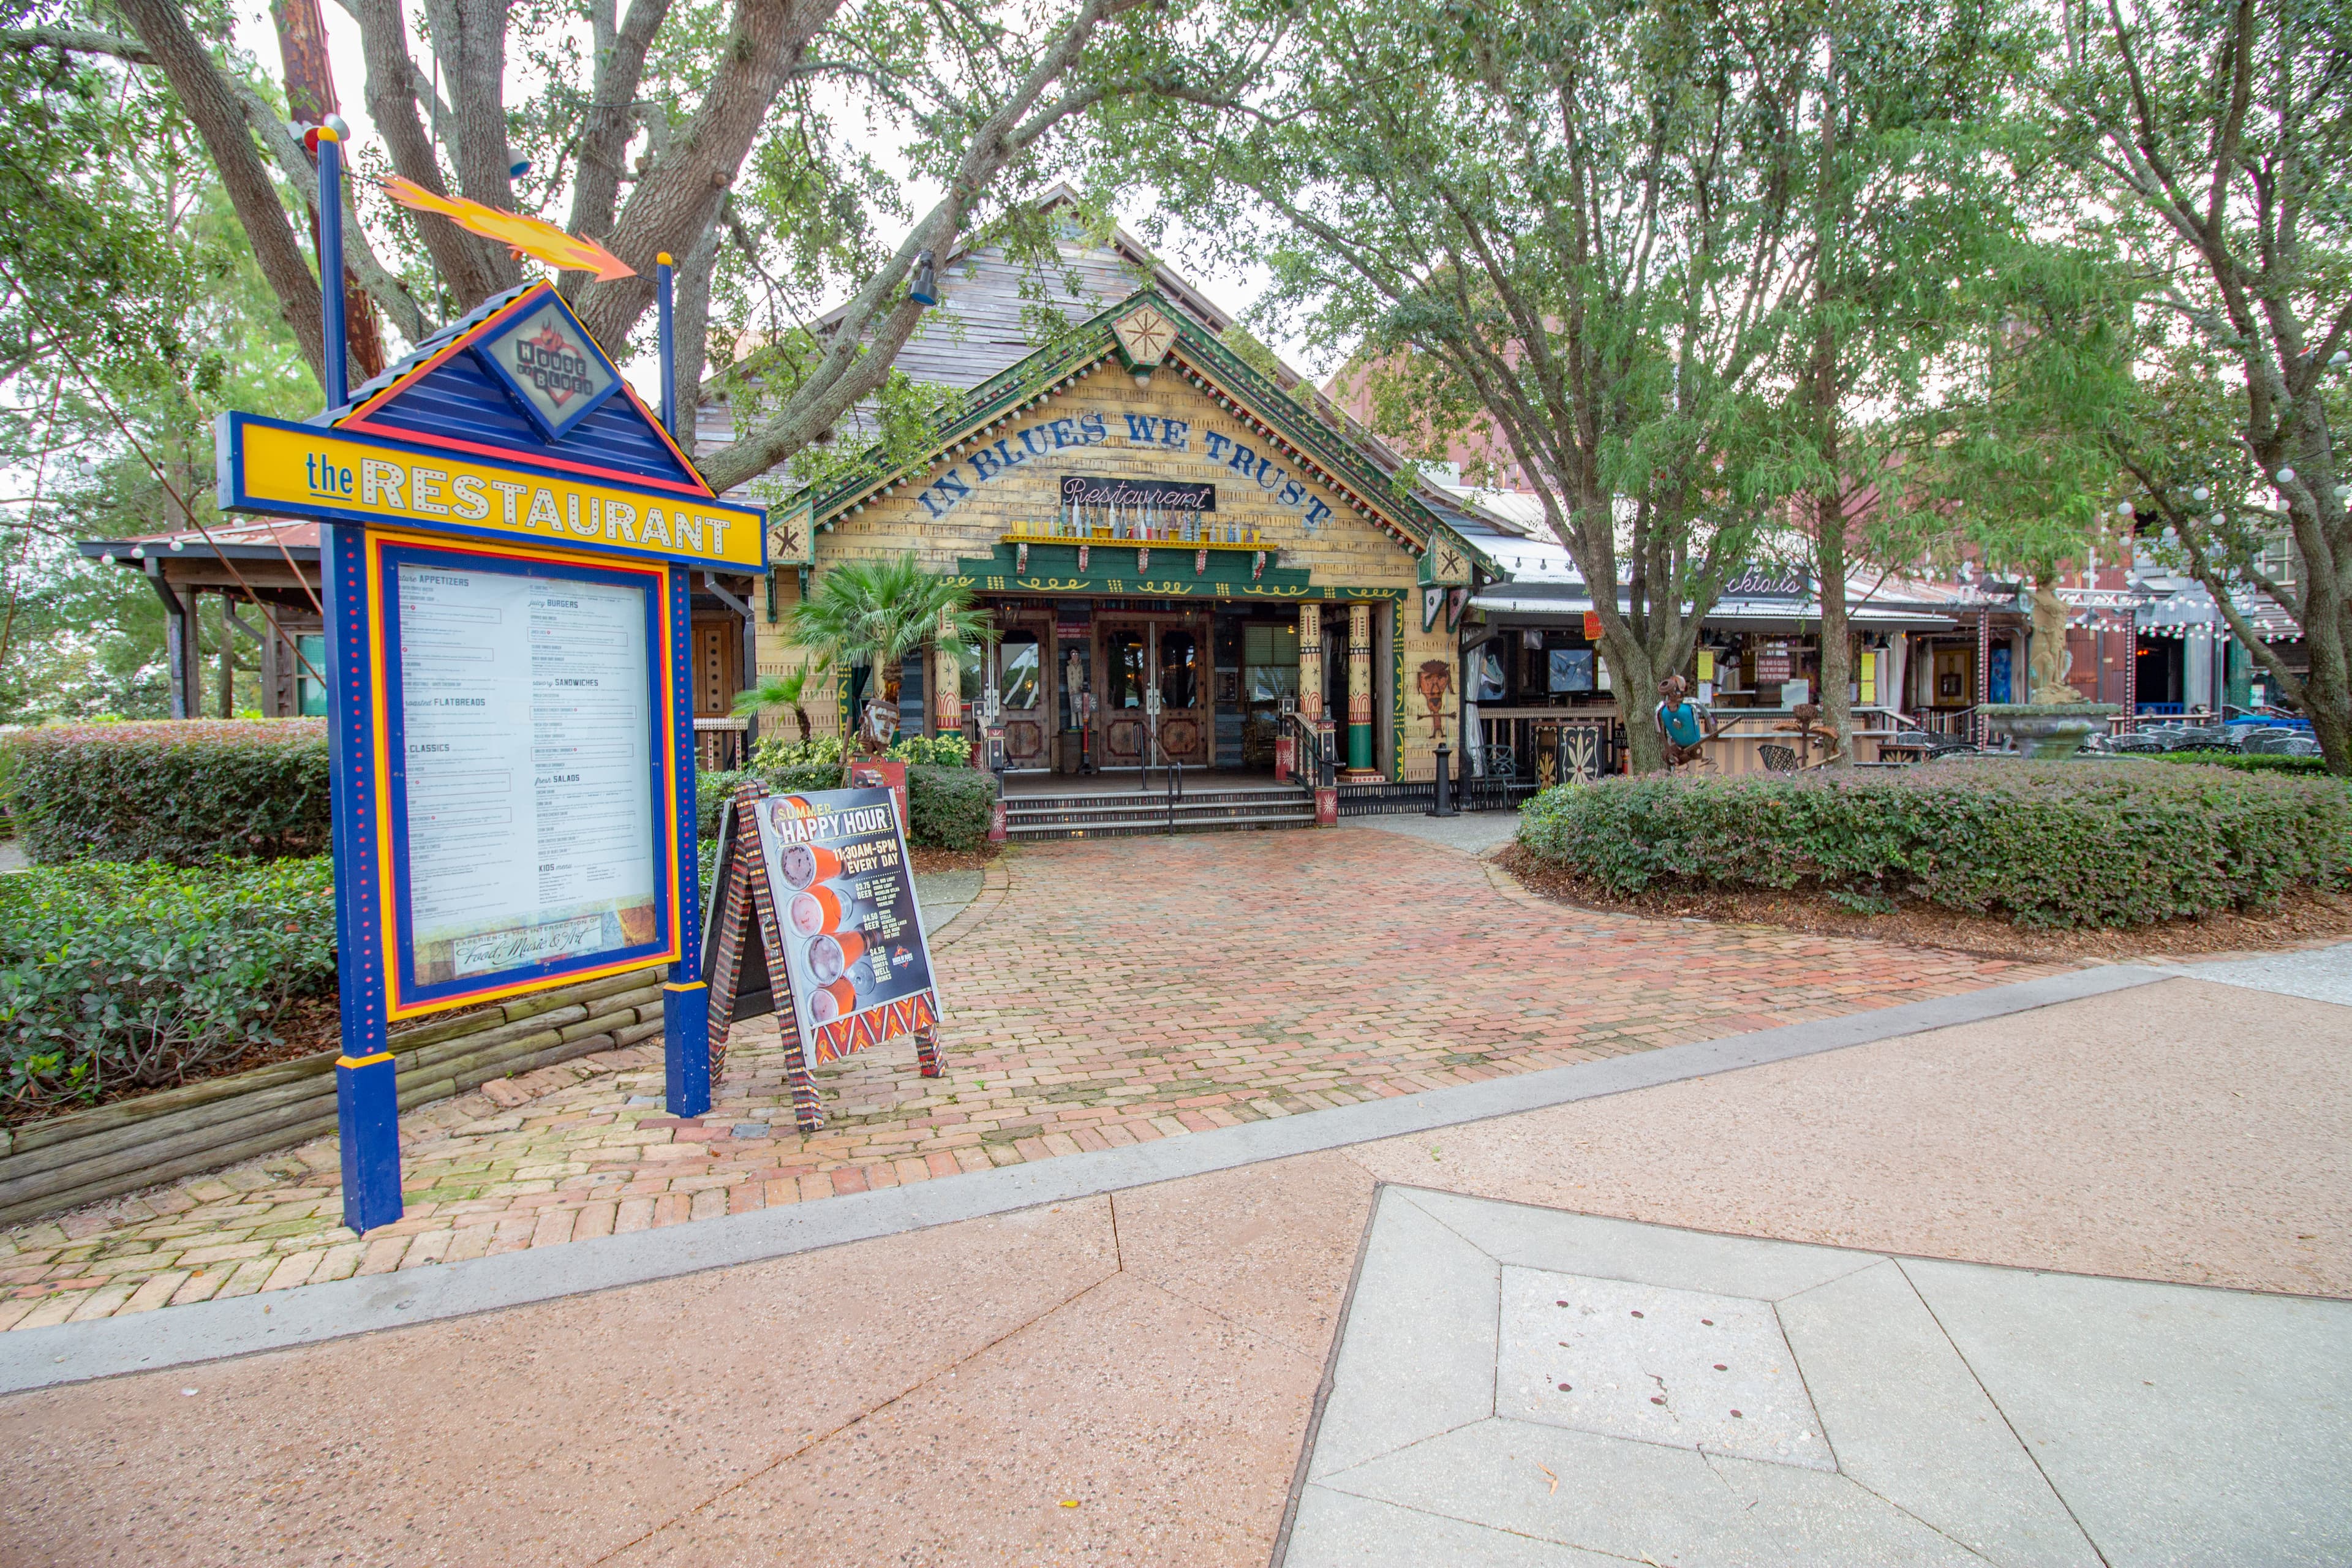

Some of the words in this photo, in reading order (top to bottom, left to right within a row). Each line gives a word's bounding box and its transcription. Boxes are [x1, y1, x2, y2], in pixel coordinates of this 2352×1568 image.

[518, 341, 586, 376] HOUSE
[534, 369, 592, 395] BLUES
[918, 468, 971, 519] IN
[967, 413, 1107, 481] BLUES
[1123, 413, 1189, 447] WE
[1205, 430, 1331, 525] TRUST
[1063, 477, 1211, 509] Restaurant
[306, 453, 353, 495] the
[361, 457, 731, 555] RESTAURANT
[420, 575, 469, 587] APPETIZERS
[528, 599, 545, 608] juicy
[547, 599, 578, 609] BURGERS
[555, 678, 598, 687] SANDWICHES
[434, 698, 486, 706] FLATBREADS
[409, 744, 450, 753] CLASSICS
[534, 777, 551, 786] fresh
[553, 774, 580, 783] SALADS
[778, 803, 832, 821] SUMMER
[782, 814, 840, 844] HAPPY
[843, 808, 888, 834] HOUR
[833, 839, 897, 862] 11:30AM-5PM
[538, 864, 554, 873] KIDS
[846, 856, 878, 875] EVERY
[881, 852, 899, 867] DAY
[855, 881, 870, 892] $3.75
[857, 889, 872, 900] BEER
[862, 912, 878, 922] $4.50
[864, 920, 880, 931] BEER
[456, 933, 510, 947] EXPERIENCE
[530, 919, 587, 935] INTERSECTION
[456, 940, 505, 965] Food,
[496, 937, 546, 961] Music
[549, 932, 562, 948] &
[560, 927, 600, 950] Art
[870, 946, 885, 957] $4.50
[871, 953, 887, 963] HOUSE
[873, 966, 891, 977] WELL
[875, 973, 892, 984] DRINKS
